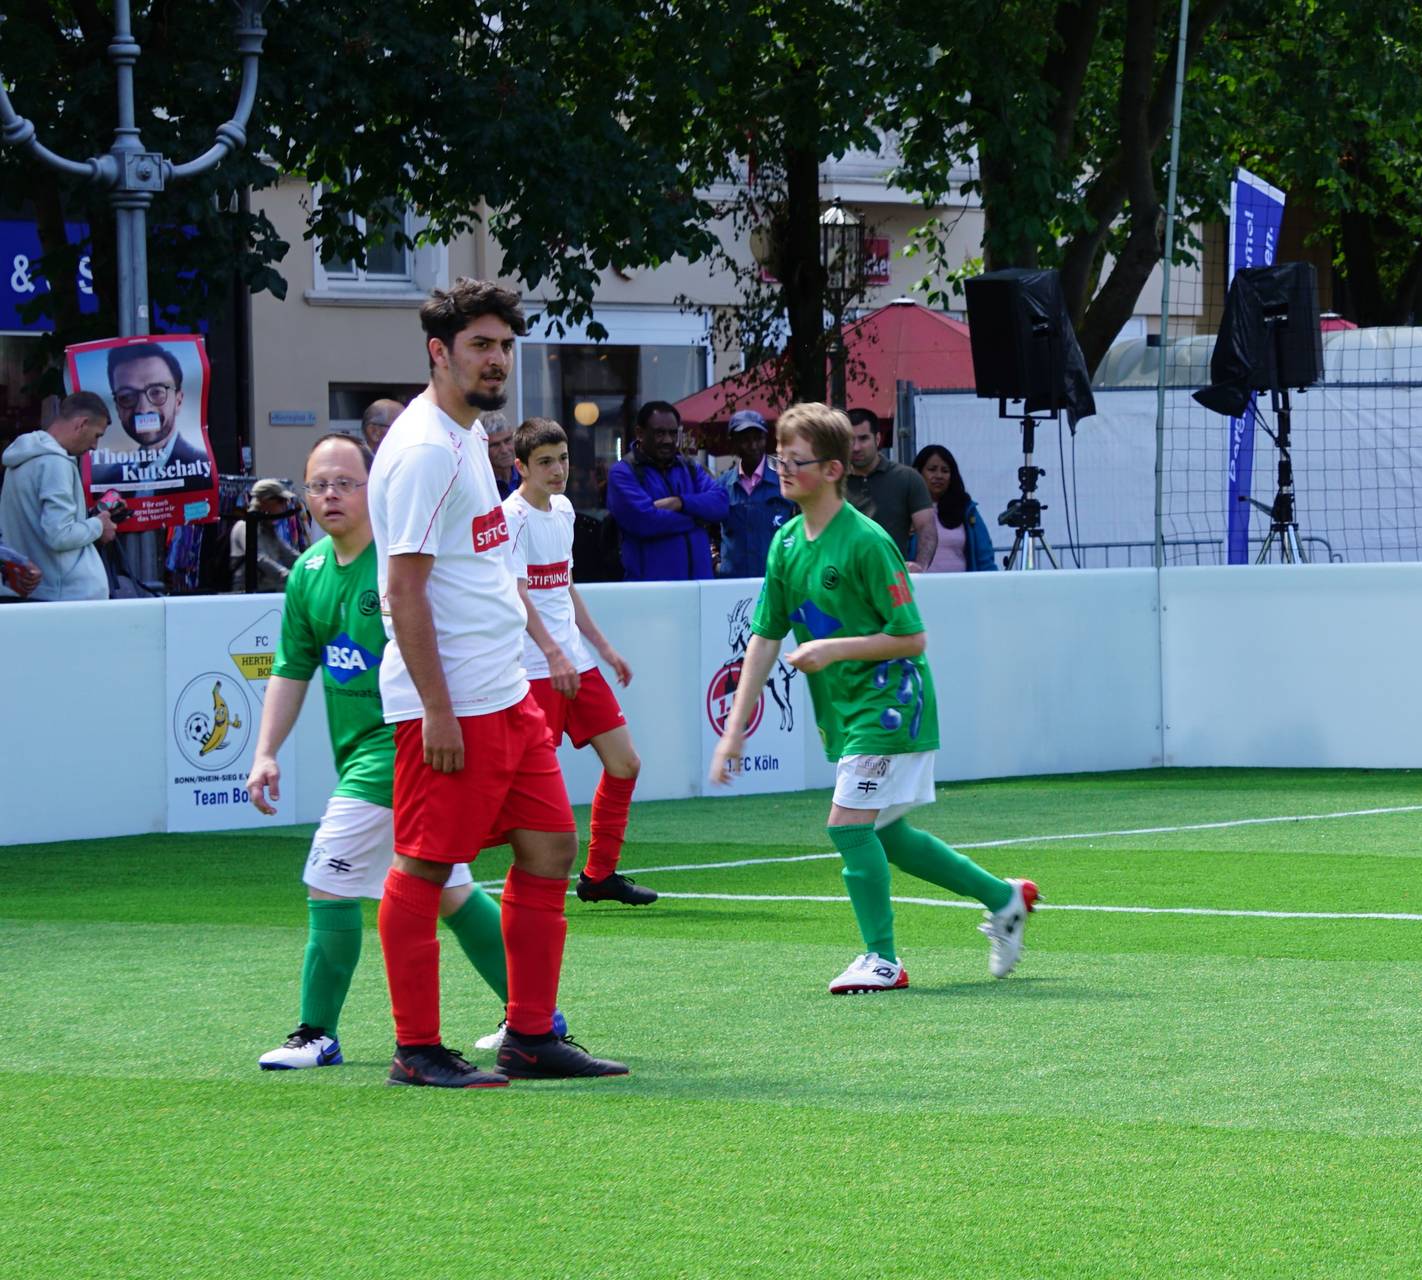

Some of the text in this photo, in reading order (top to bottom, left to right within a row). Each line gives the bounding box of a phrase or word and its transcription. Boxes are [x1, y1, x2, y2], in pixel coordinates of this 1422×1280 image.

[89, 447, 167, 465] Thomas
[122, 459, 212, 481] Kutschaty
[528, 572, 568, 586] STIFTUNG
[255, 636, 269, 647] FC
[755, 755, 779, 770] Köln
[193, 786, 251, 806] Team Bo
